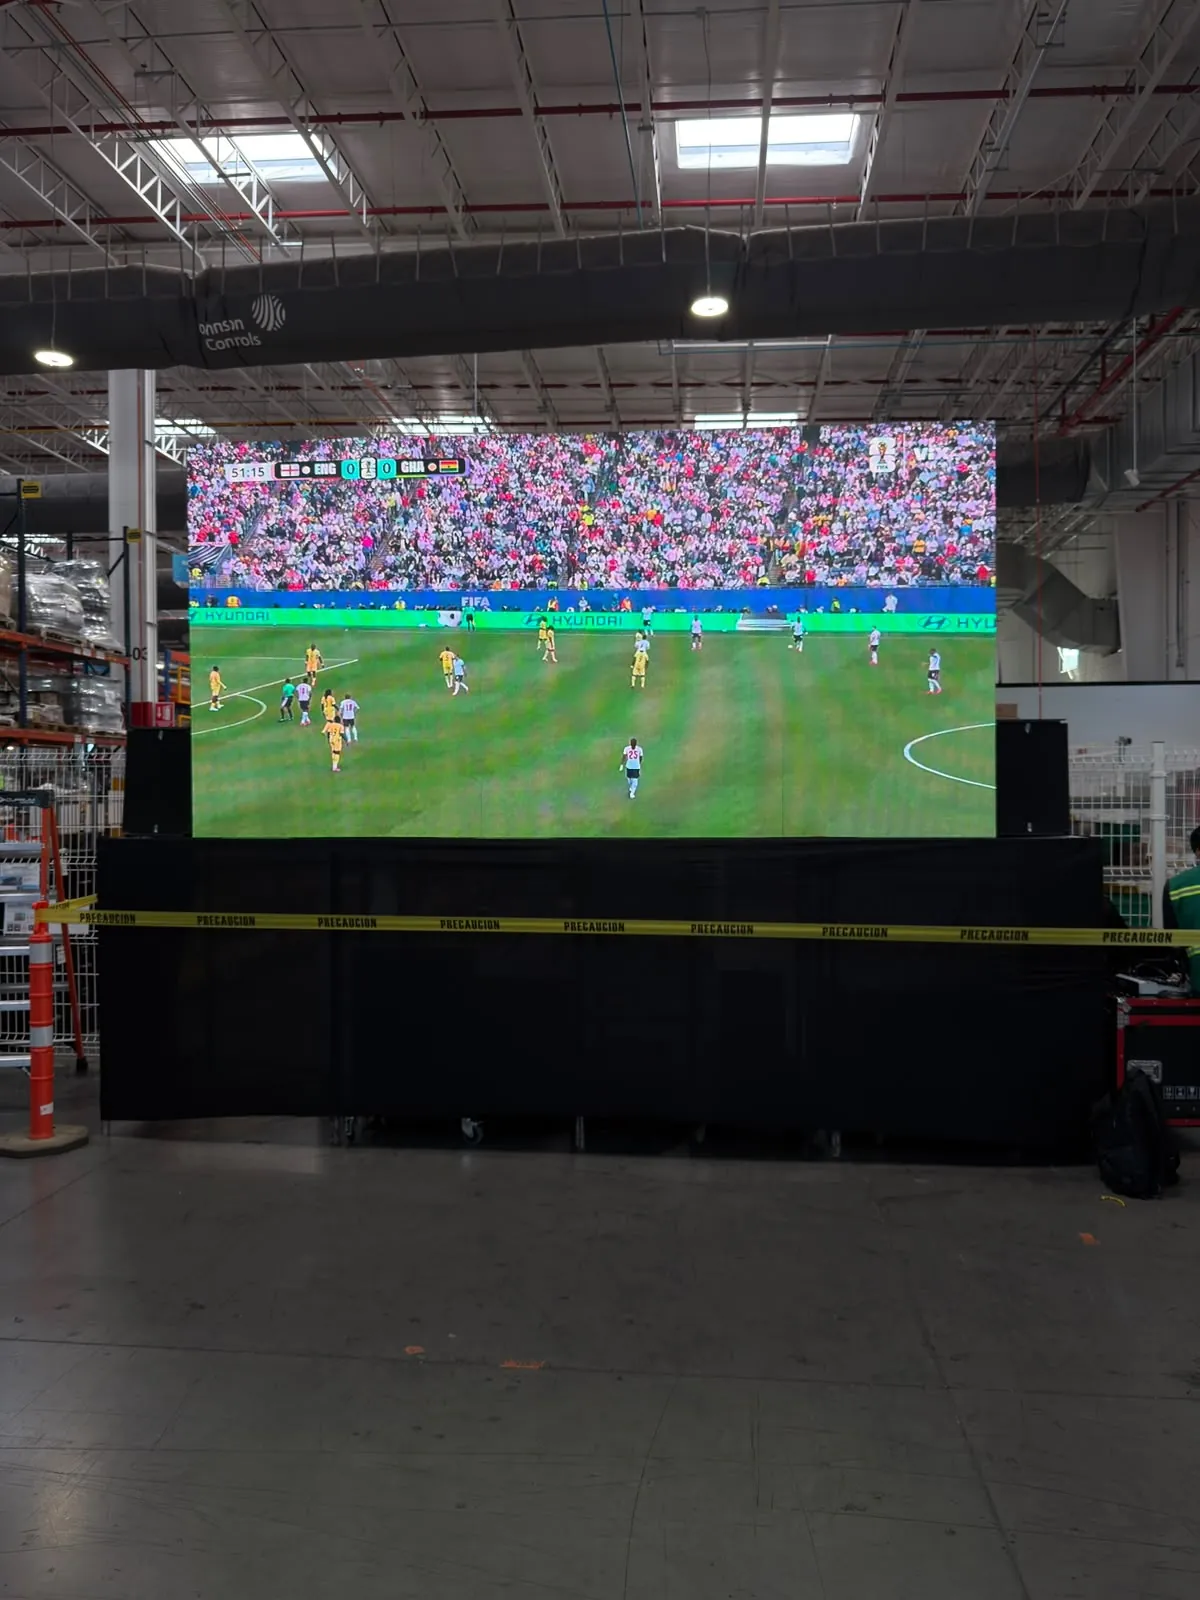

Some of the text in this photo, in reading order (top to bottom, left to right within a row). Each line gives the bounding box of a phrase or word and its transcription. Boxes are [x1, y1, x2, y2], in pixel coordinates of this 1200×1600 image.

[231, 461, 425, 478] 51:15 ENG 0 0 GHA
[461, 596, 490, 607] FIFA
[205, 611, 269, 621] HYUNDAI
[552, 615, 622, 626] HYUNDAI
[80, 912, 1173, 944] PRECAUCION PRECAUCION PRECAUCION PRECAUCION PRECAUCION PRECAUCION PRECAUCION PRECAUCION PRECAUCION
